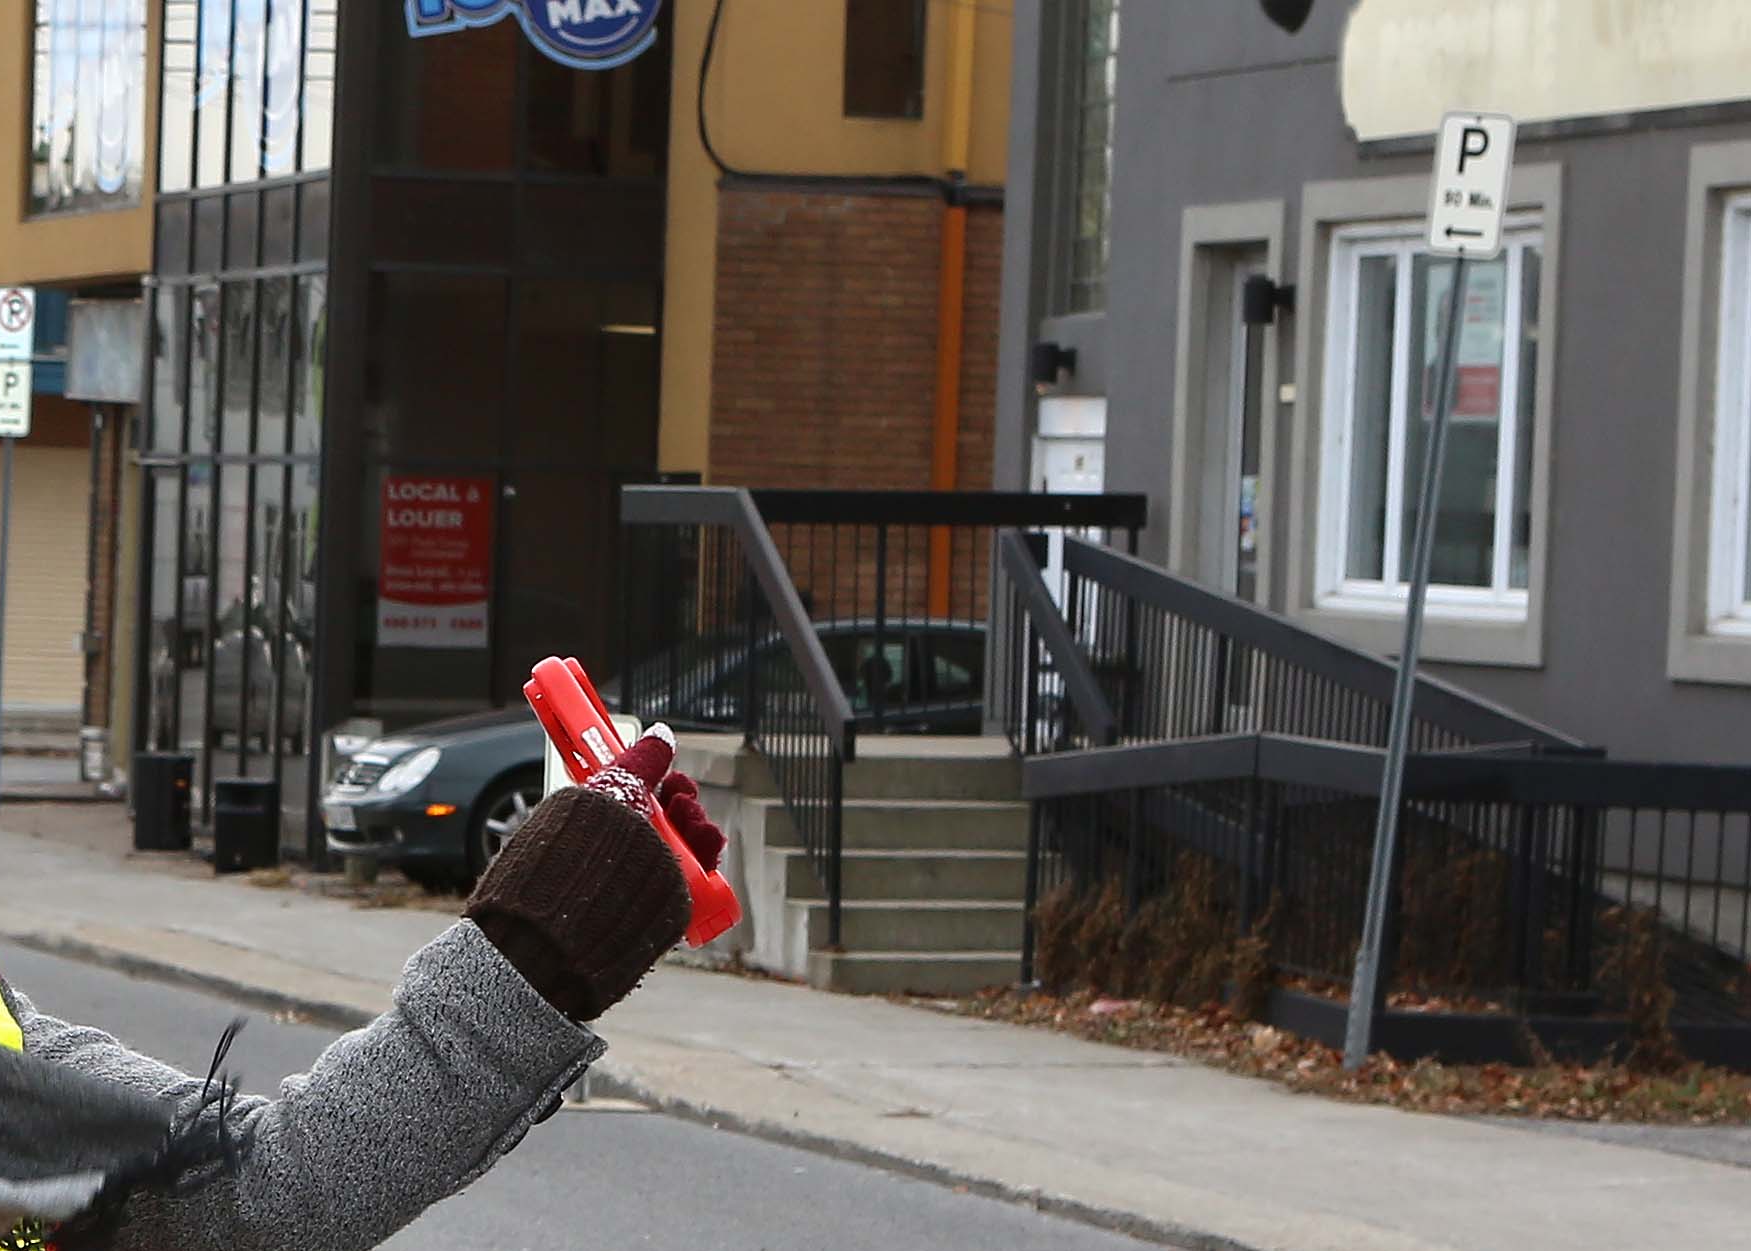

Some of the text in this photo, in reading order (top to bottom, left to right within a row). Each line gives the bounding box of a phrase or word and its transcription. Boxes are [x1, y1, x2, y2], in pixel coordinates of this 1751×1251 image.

[547, 0, 641, 28] MAX
[1458, 128, 1489, 174] P
[3, 372, 19, 397] P
[388, 482, 461, 502] LOCAL
[388, 508, 464, 528] LOUER
